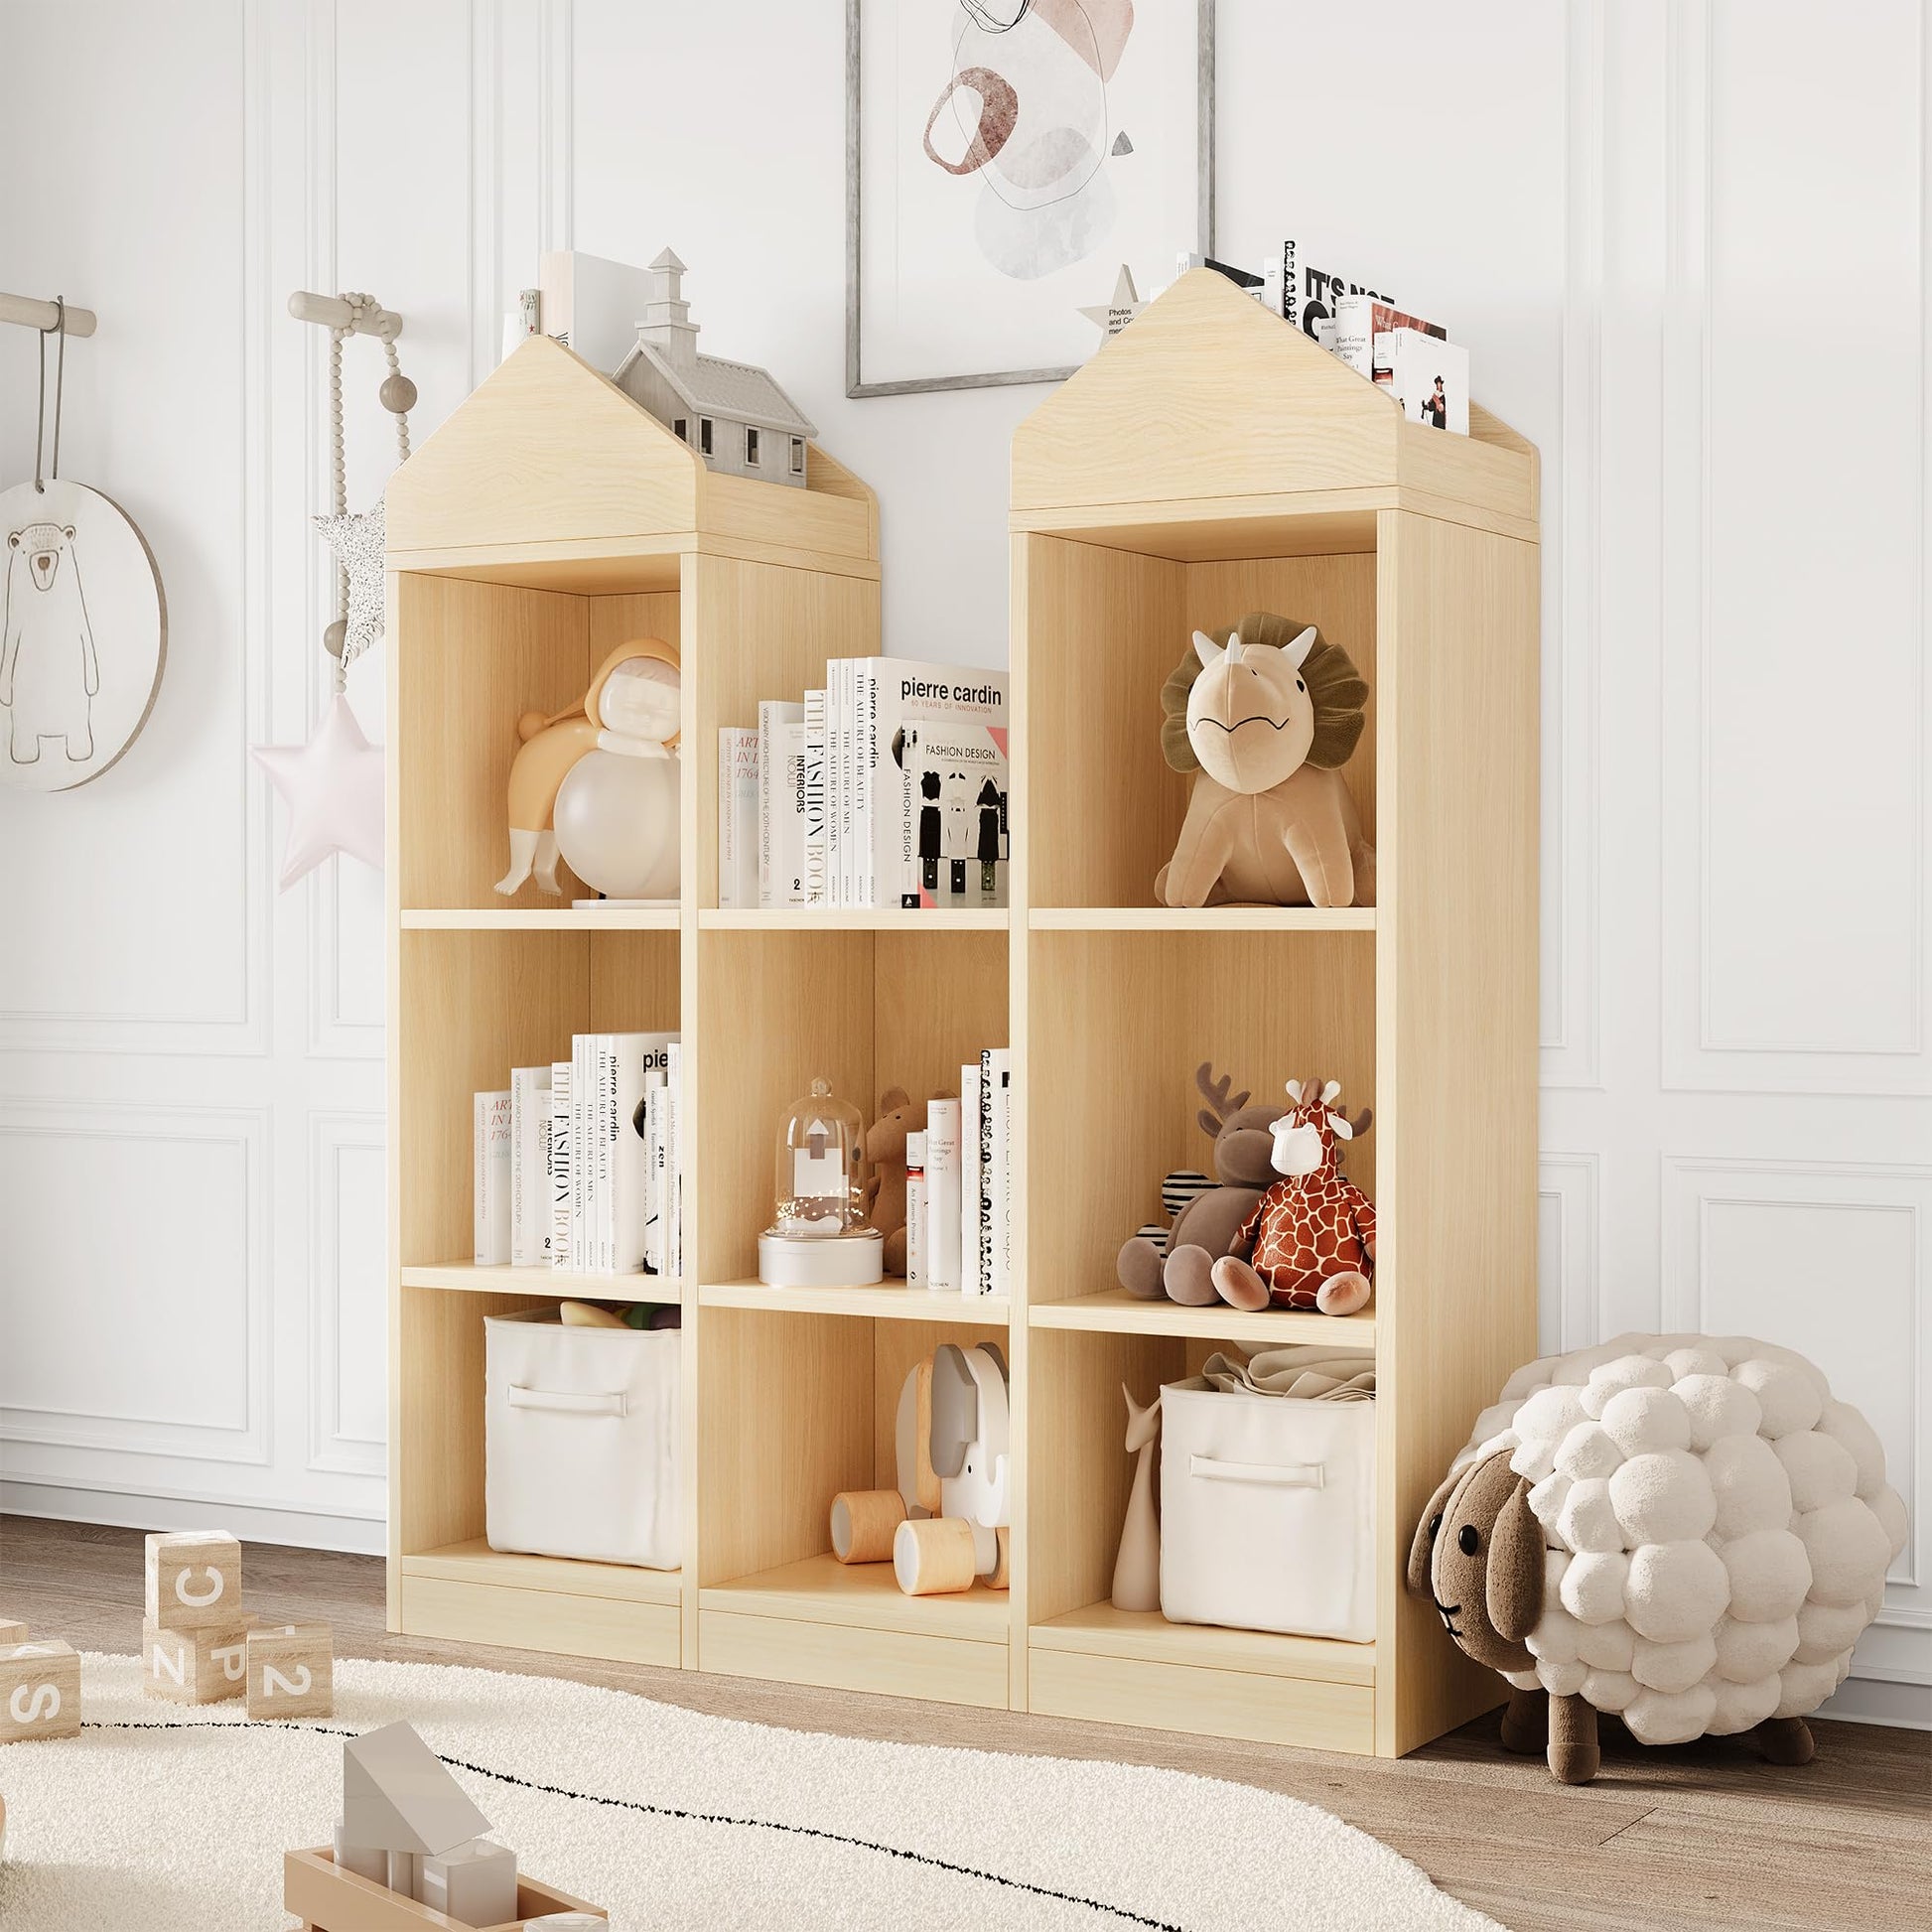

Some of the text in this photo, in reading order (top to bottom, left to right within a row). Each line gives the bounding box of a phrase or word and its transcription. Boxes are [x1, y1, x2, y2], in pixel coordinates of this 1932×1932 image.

[901, 677, 1002, 706] pierre cardin
[921, 700, 942, 709] YEARS
[955, 704, 993, 714] INNOVATION
[807, 693, 825, 740] THE
[736, 752, 750, 764] IN
[856, 673, 865, 811] THE ALLURE OF BEAUTY
[925, 745, 996, 760] FASHION DESIGN
[796, 755, 805, 814] INTERIORS
[807, 745, 825, 838] FASHION
[793, 878, 801, 892] 2
[553, 1066, 570, 1110] THE
[553, 1115, 570, 1202] FASHION
[544, 1236, 552, 1250] 2
[175, 1566, 224, 1607] C
[210, 1644, 246, 1681] P
[263, 1664, 312, 1698] 2
[10, 1683, 61, 1724] S
